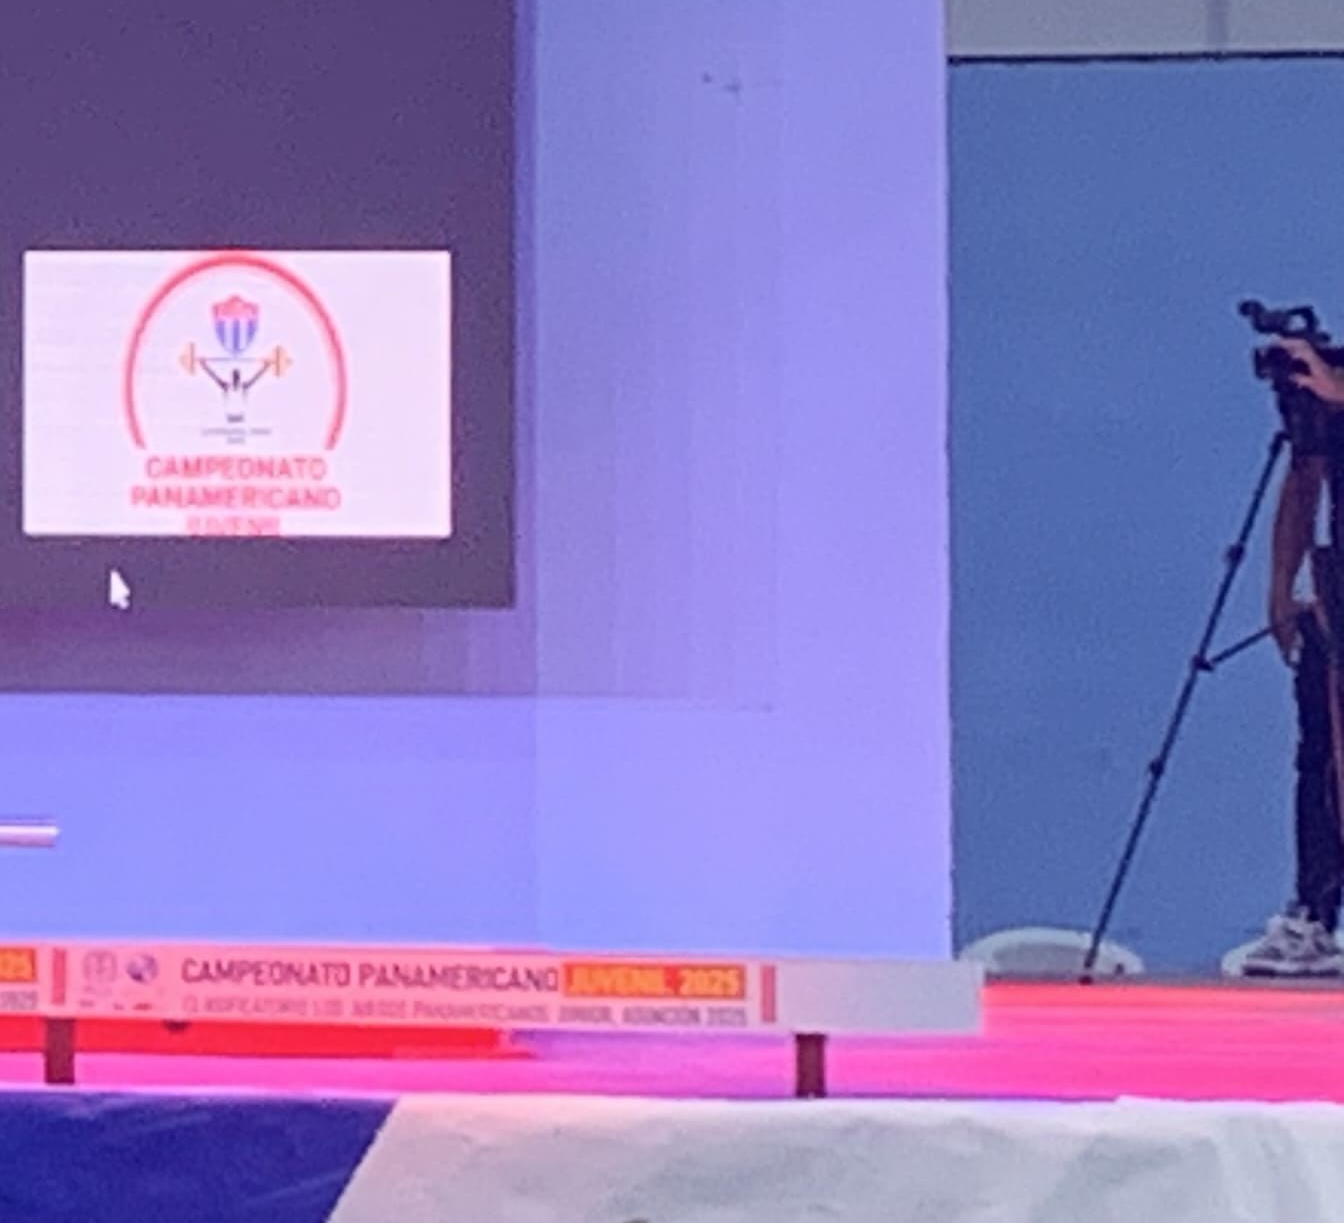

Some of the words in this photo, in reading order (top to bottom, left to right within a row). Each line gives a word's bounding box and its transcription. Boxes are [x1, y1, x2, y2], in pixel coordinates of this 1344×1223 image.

[145, 456, 327, 481] CAMPEONATO
[130, 485, 342, 511] PANAMERICANO
[180, 958, 351, 988] CAMPEONATO
[358, 962, 559, 994] PANAMERICANO
[679, 968, 739, 995] 2025
